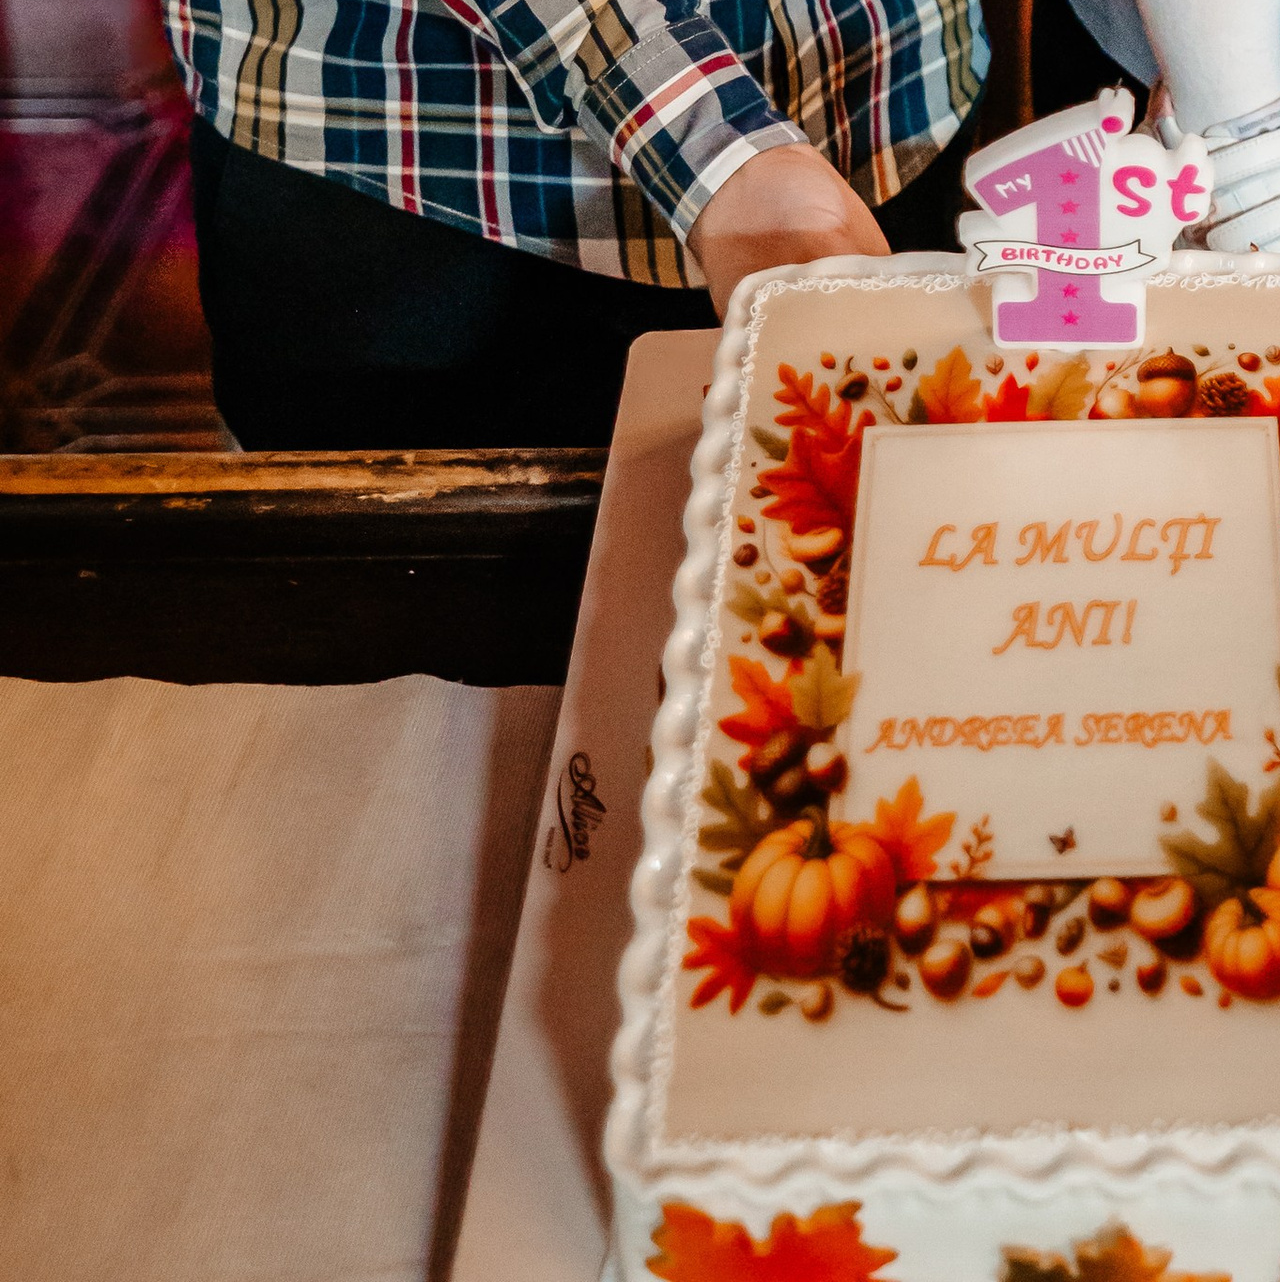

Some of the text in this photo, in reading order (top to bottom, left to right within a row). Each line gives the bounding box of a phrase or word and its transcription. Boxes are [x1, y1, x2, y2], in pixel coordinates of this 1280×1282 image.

[1001, 246, 1124, 271] BIRTHDAY
[918, 521, 999, 572] LA
[991, 598, 1138, 655] ANI!
[865, 707, 1233, 754] ANDREEA SERENA
